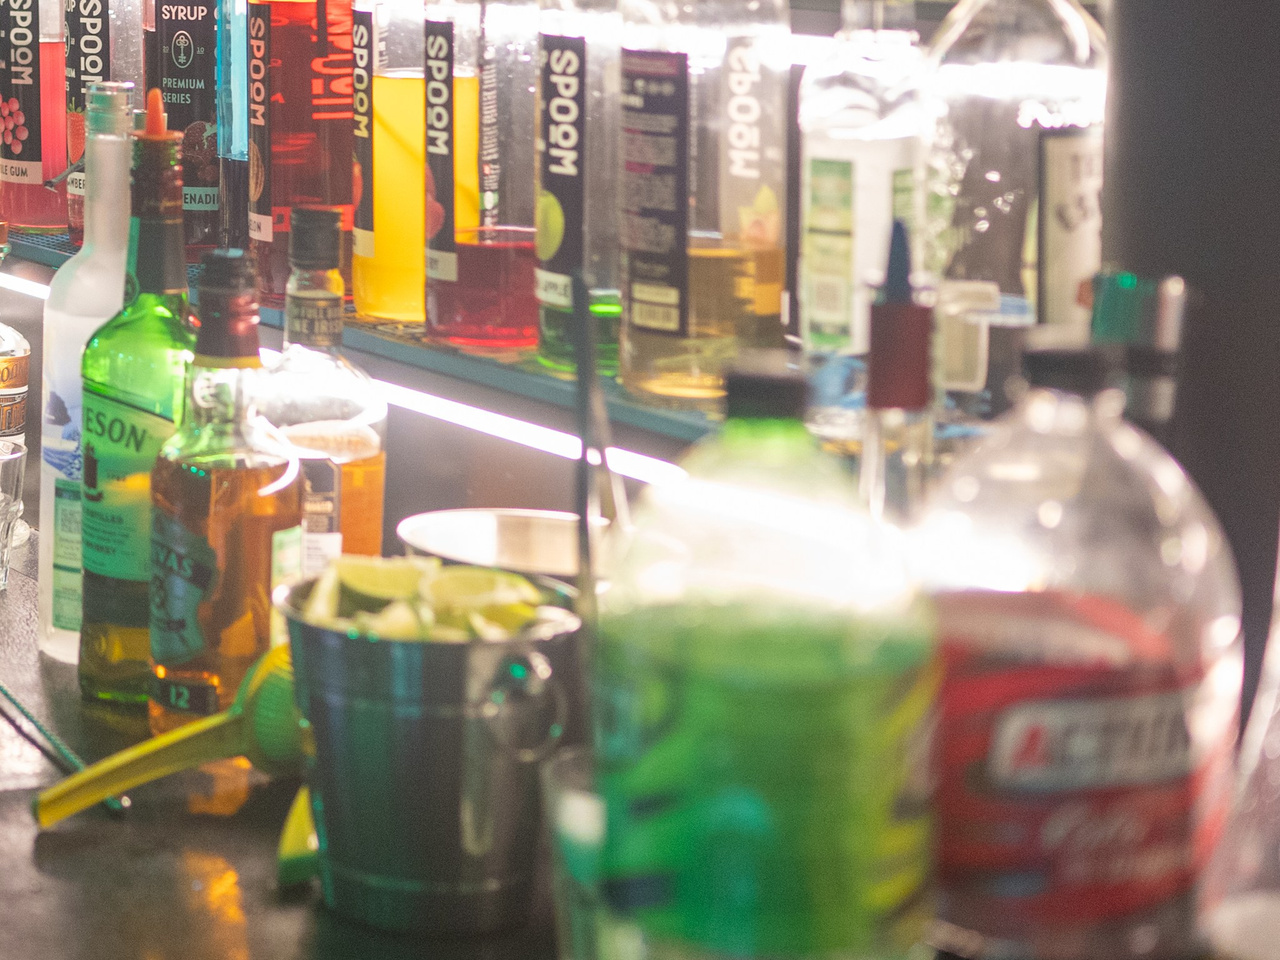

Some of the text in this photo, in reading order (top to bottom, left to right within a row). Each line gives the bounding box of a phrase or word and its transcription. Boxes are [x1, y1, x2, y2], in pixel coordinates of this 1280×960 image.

[161, 5, 208, 21] SYRUP
[162, 77, 206, 90] PREMIUM
[249, 16, 266, 127] SPOOM
[353, 24, 370, 139] SPOOM
[162, 92, 192, 105] SERIES
[426, 35, 450, 156] SPOOM
[549, 48, 580, 177] SPOOM
[10, 165, 29, 179] GUM
[169, 684, 190, 710] 12
